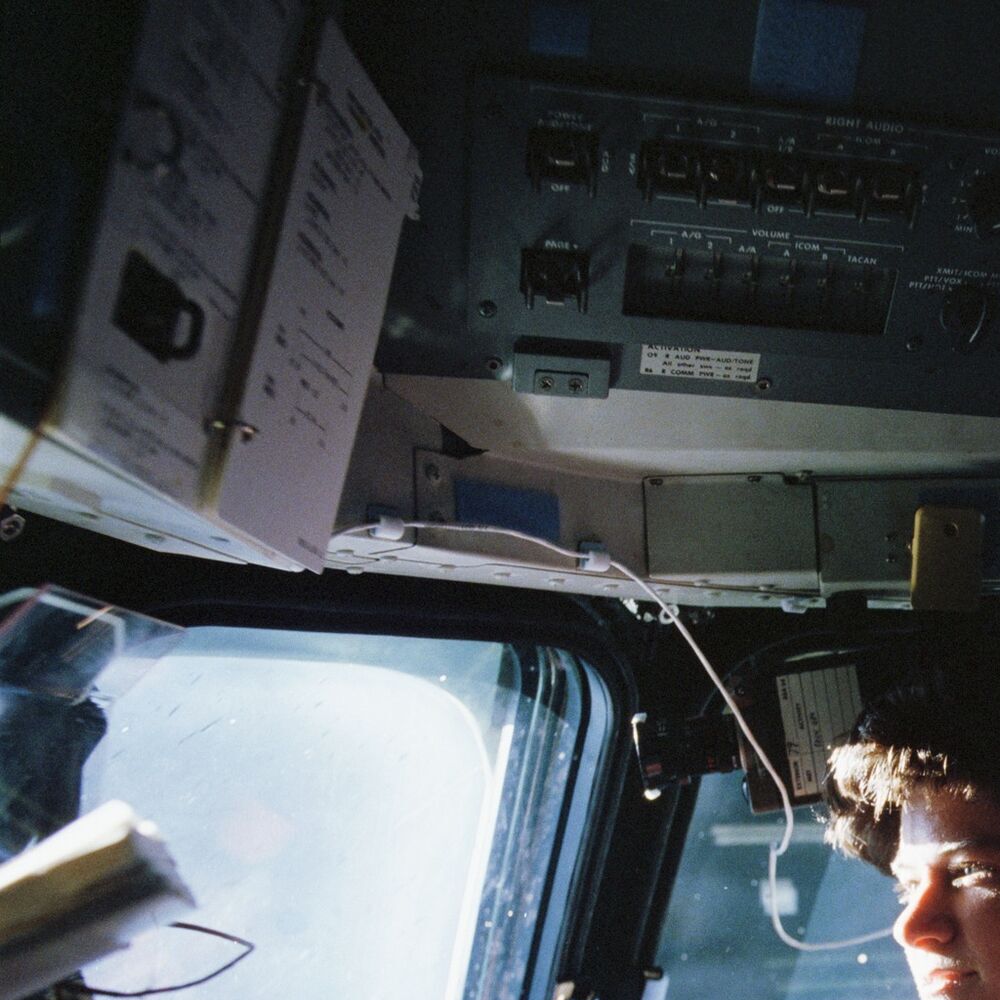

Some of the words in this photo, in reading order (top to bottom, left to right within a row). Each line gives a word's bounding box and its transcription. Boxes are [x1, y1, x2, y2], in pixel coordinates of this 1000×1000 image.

[825, 115, 861, 127] RIGHT
[865, 120, 904, 133] AUDIO
[767, 204, 784, 214] OFF
[681, 230, 702, 241] A/G
[752, 228, 791, 241] VOLUME
[738, 245, 757, 256] A/A
[795, 242, 820, 252] ICOM
[783, 249, 791, 258] A
[847, 254, 878, 266] TACAN
[648, 344, 700, 353] ACTIVATION
